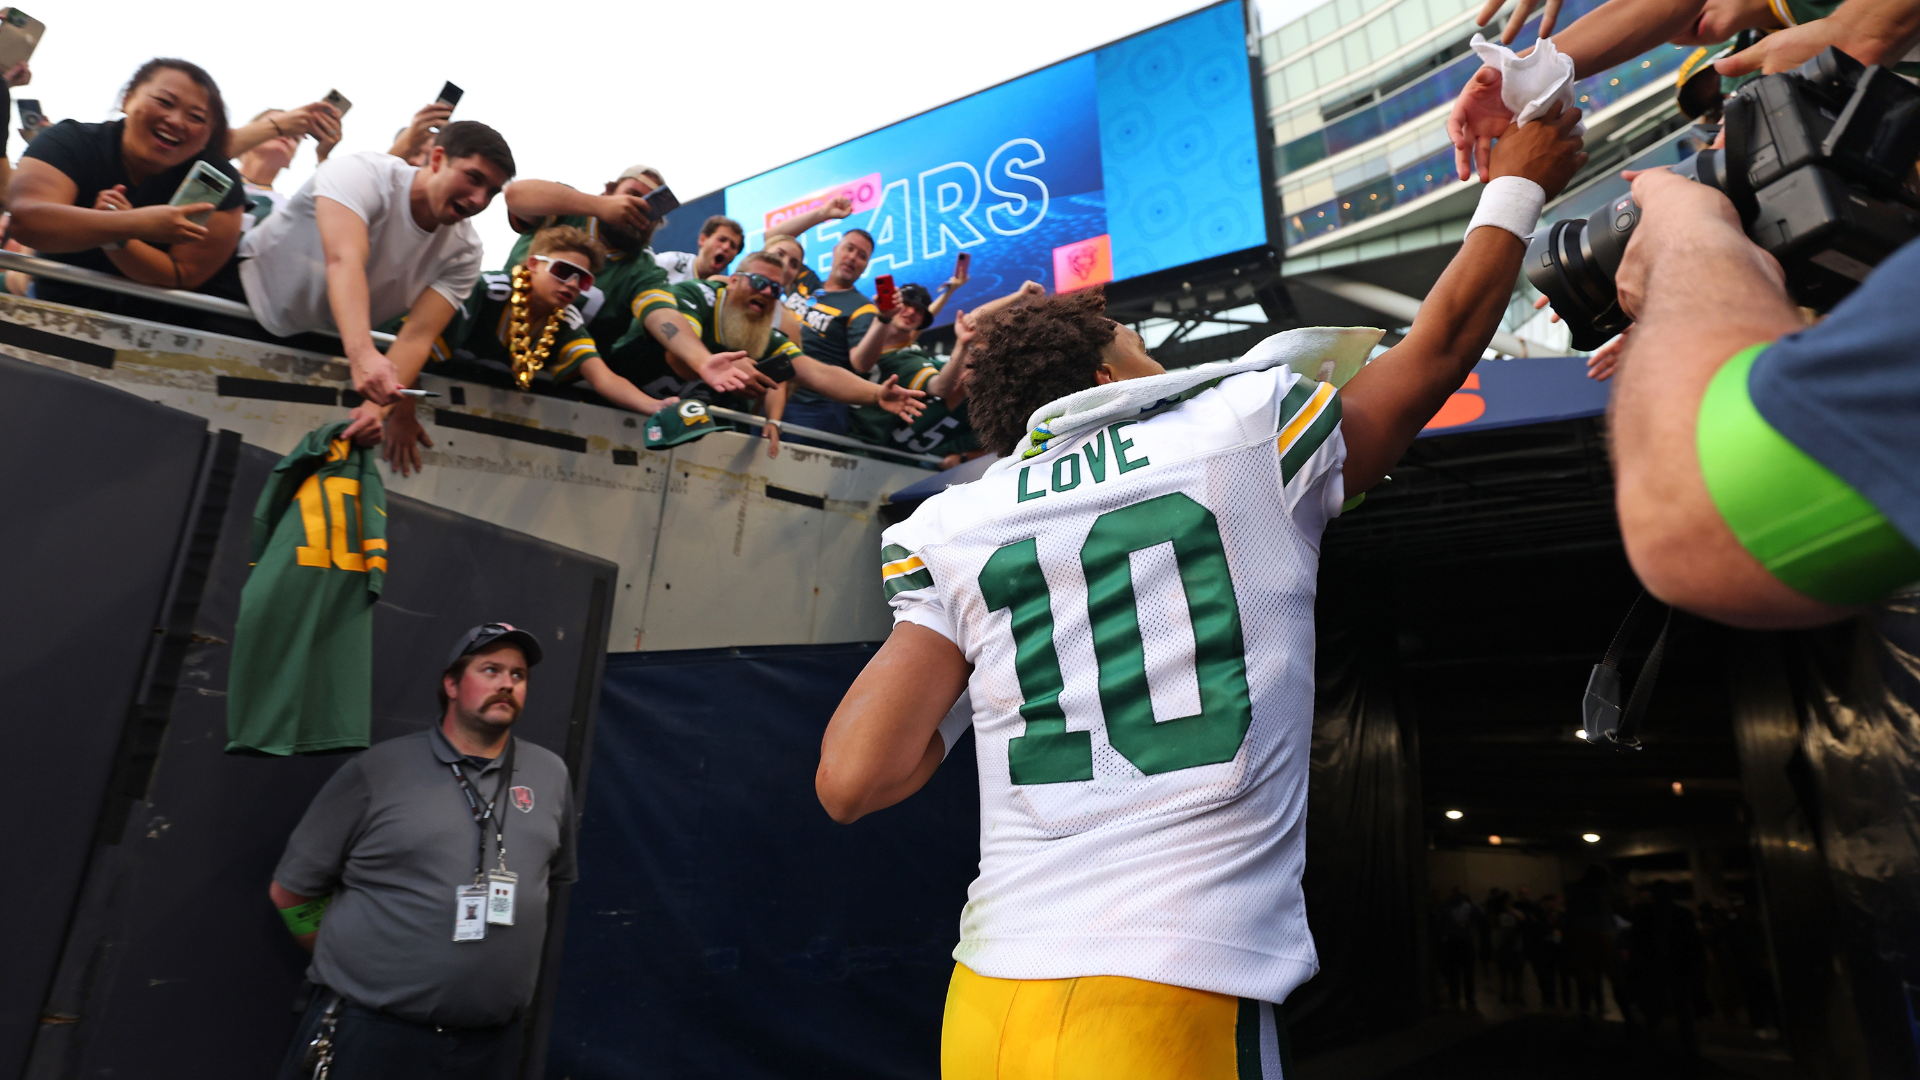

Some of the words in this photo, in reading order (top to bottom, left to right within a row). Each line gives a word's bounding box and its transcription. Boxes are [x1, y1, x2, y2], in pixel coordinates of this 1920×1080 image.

[746, 138, 1049, 279] EARS
[769, 184, 873, 230] CCGO
[1017, 421, 1150, 503] LOVE
[292, 474, 368, 572] 10
[978, 491, 1252, 785] 10
